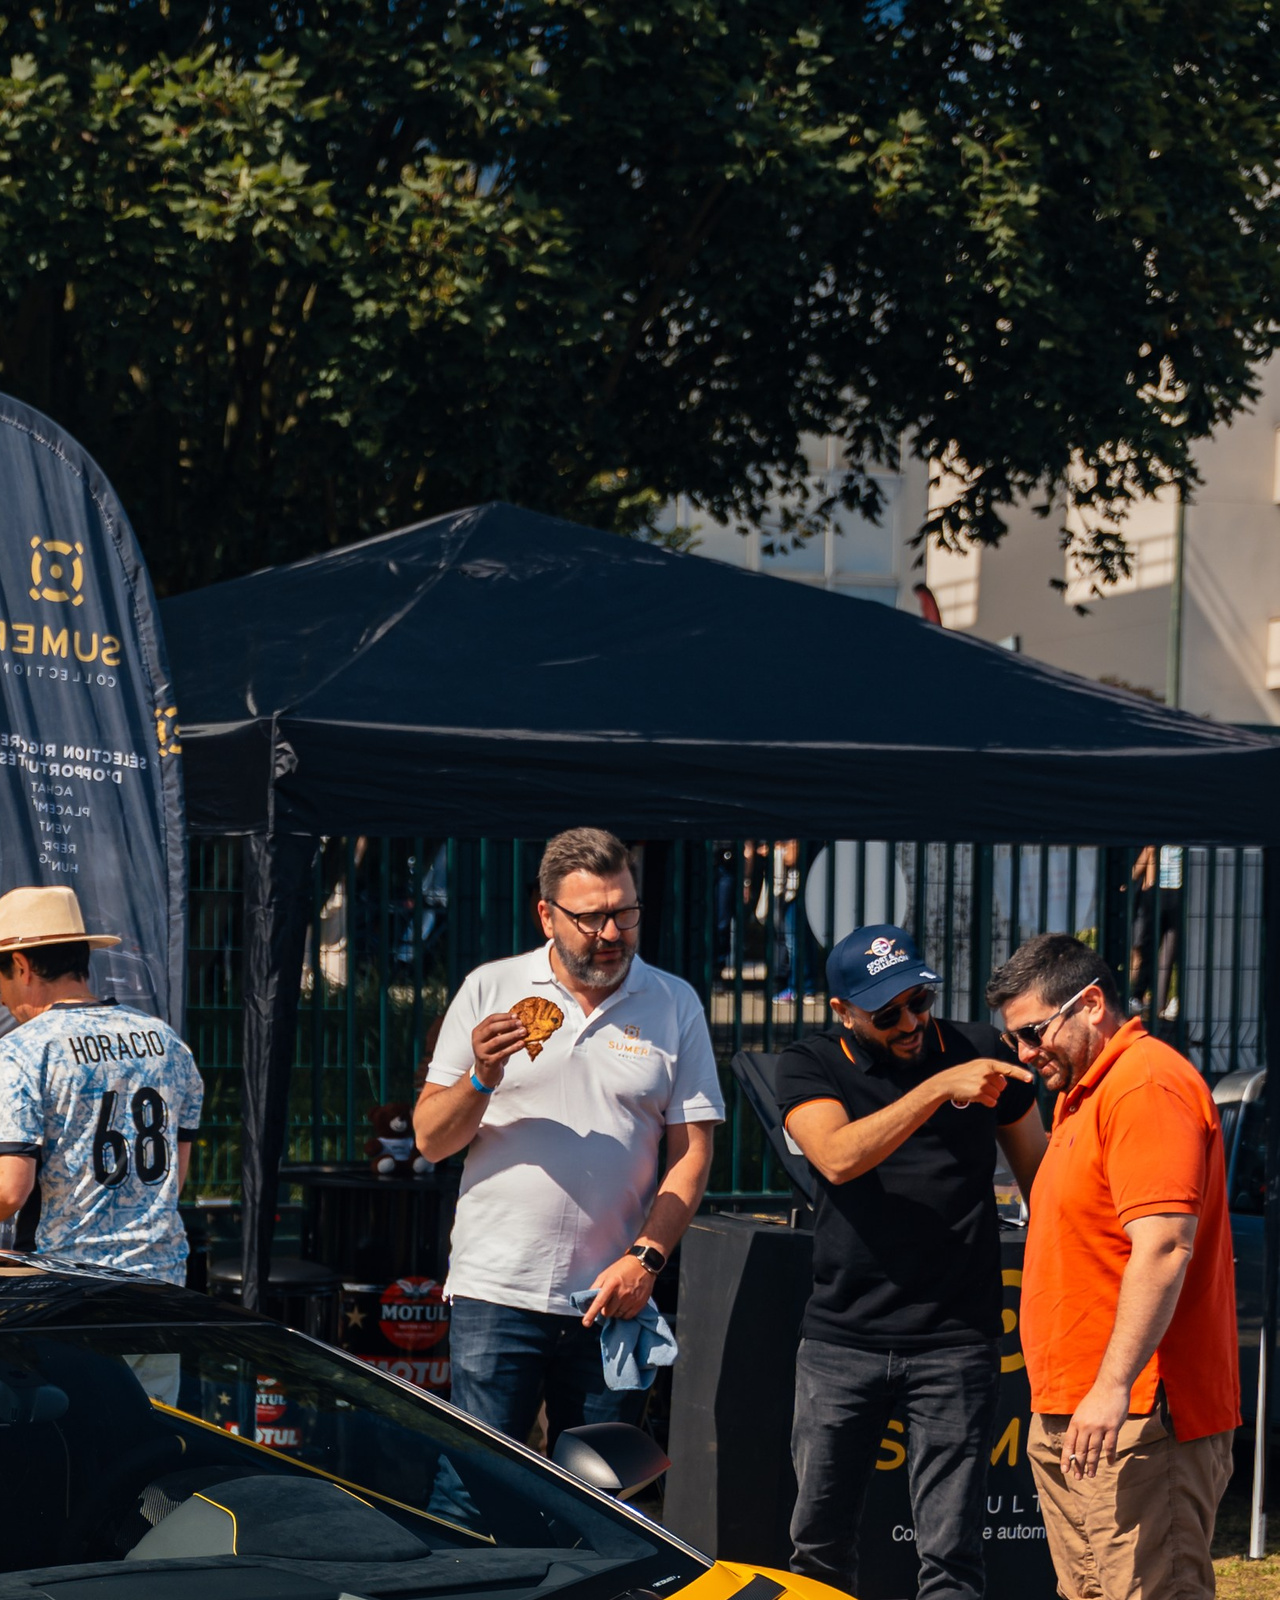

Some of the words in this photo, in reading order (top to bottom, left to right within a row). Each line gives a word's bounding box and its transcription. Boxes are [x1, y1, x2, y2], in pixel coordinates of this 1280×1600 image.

[68, 1030, 166, 1065] HORACIO
[608, 1040, 648, 1056] SUMER
[93, 1087, 169, 1190] 68
[381, 1304, 449, 1320] MOTUL
[370, 1361, 451, 1384] OTU
[997, 1525, 1046, 1541] autom
